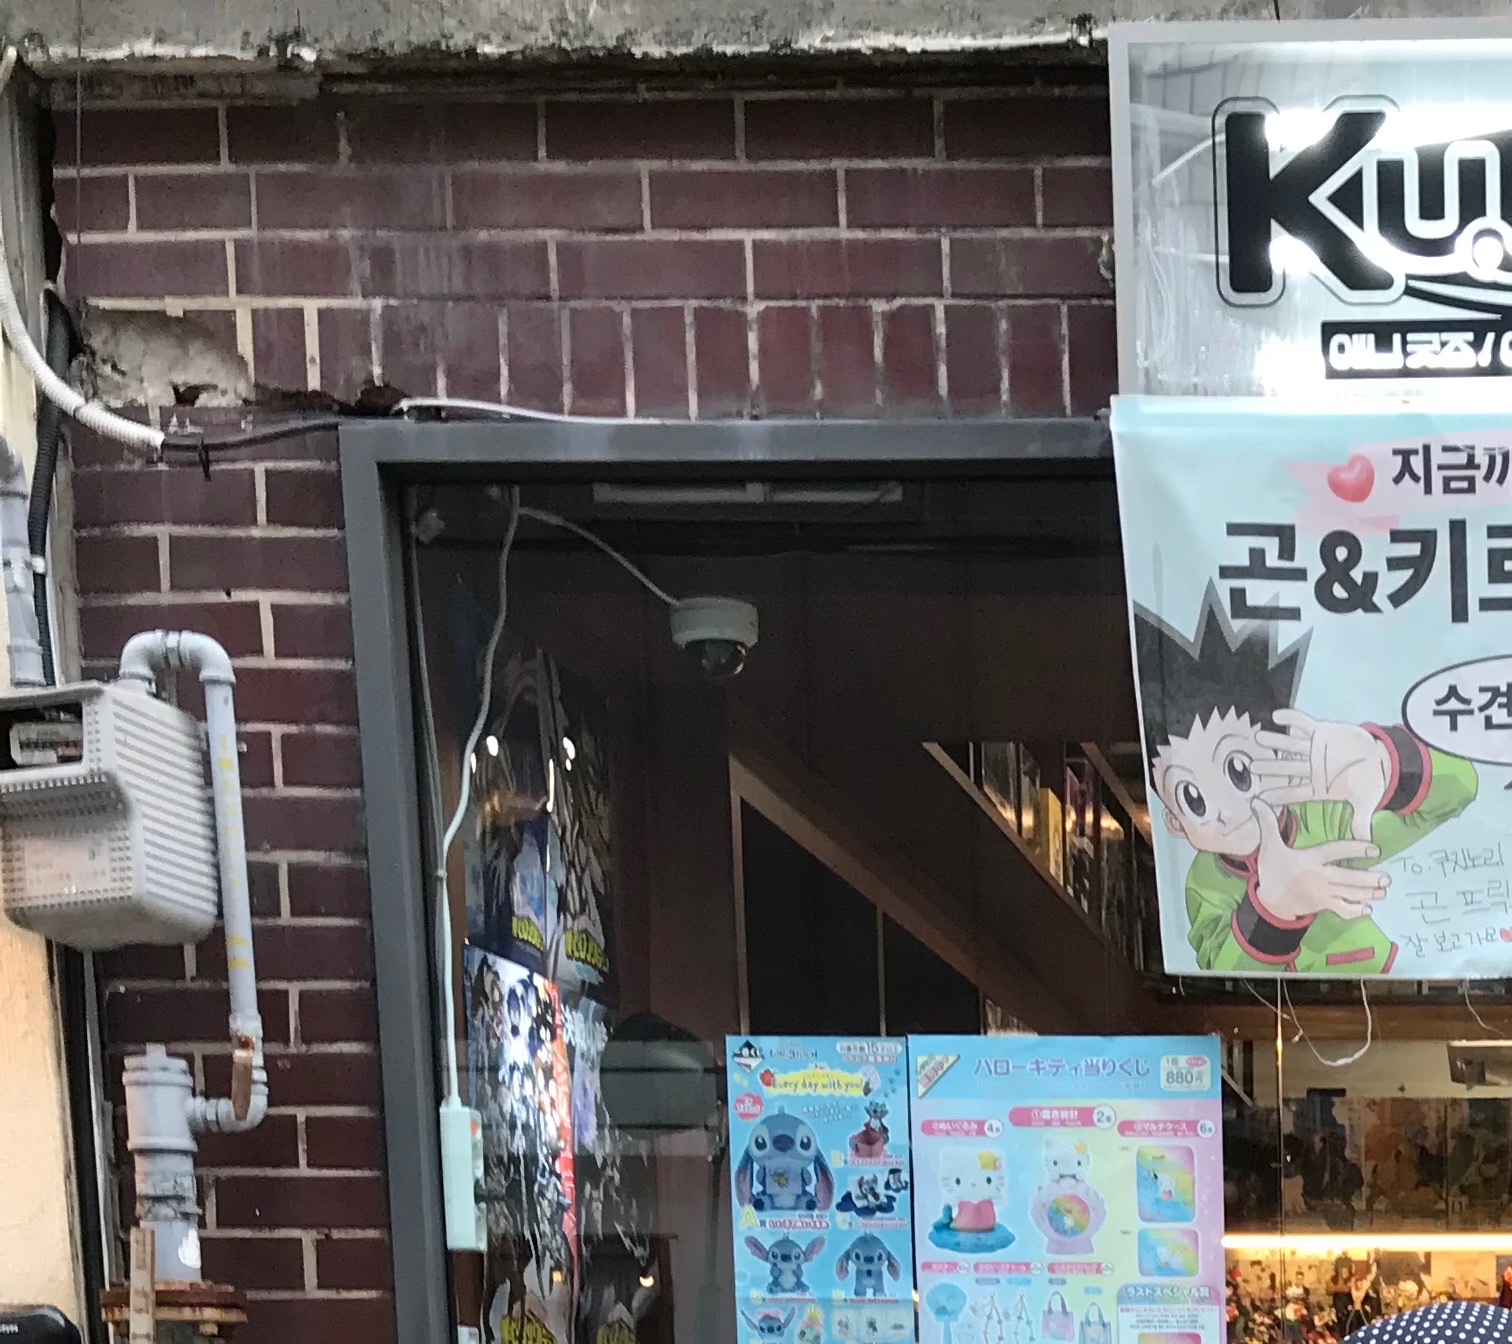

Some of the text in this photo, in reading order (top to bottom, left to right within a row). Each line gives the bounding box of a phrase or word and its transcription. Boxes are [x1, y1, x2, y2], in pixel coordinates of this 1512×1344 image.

[1405, 891, 1450, 925] 곤
[1399, 932, 1429, 958] 잘
[973, 1056, 1150, 1077] ハローキティ当りくじ
